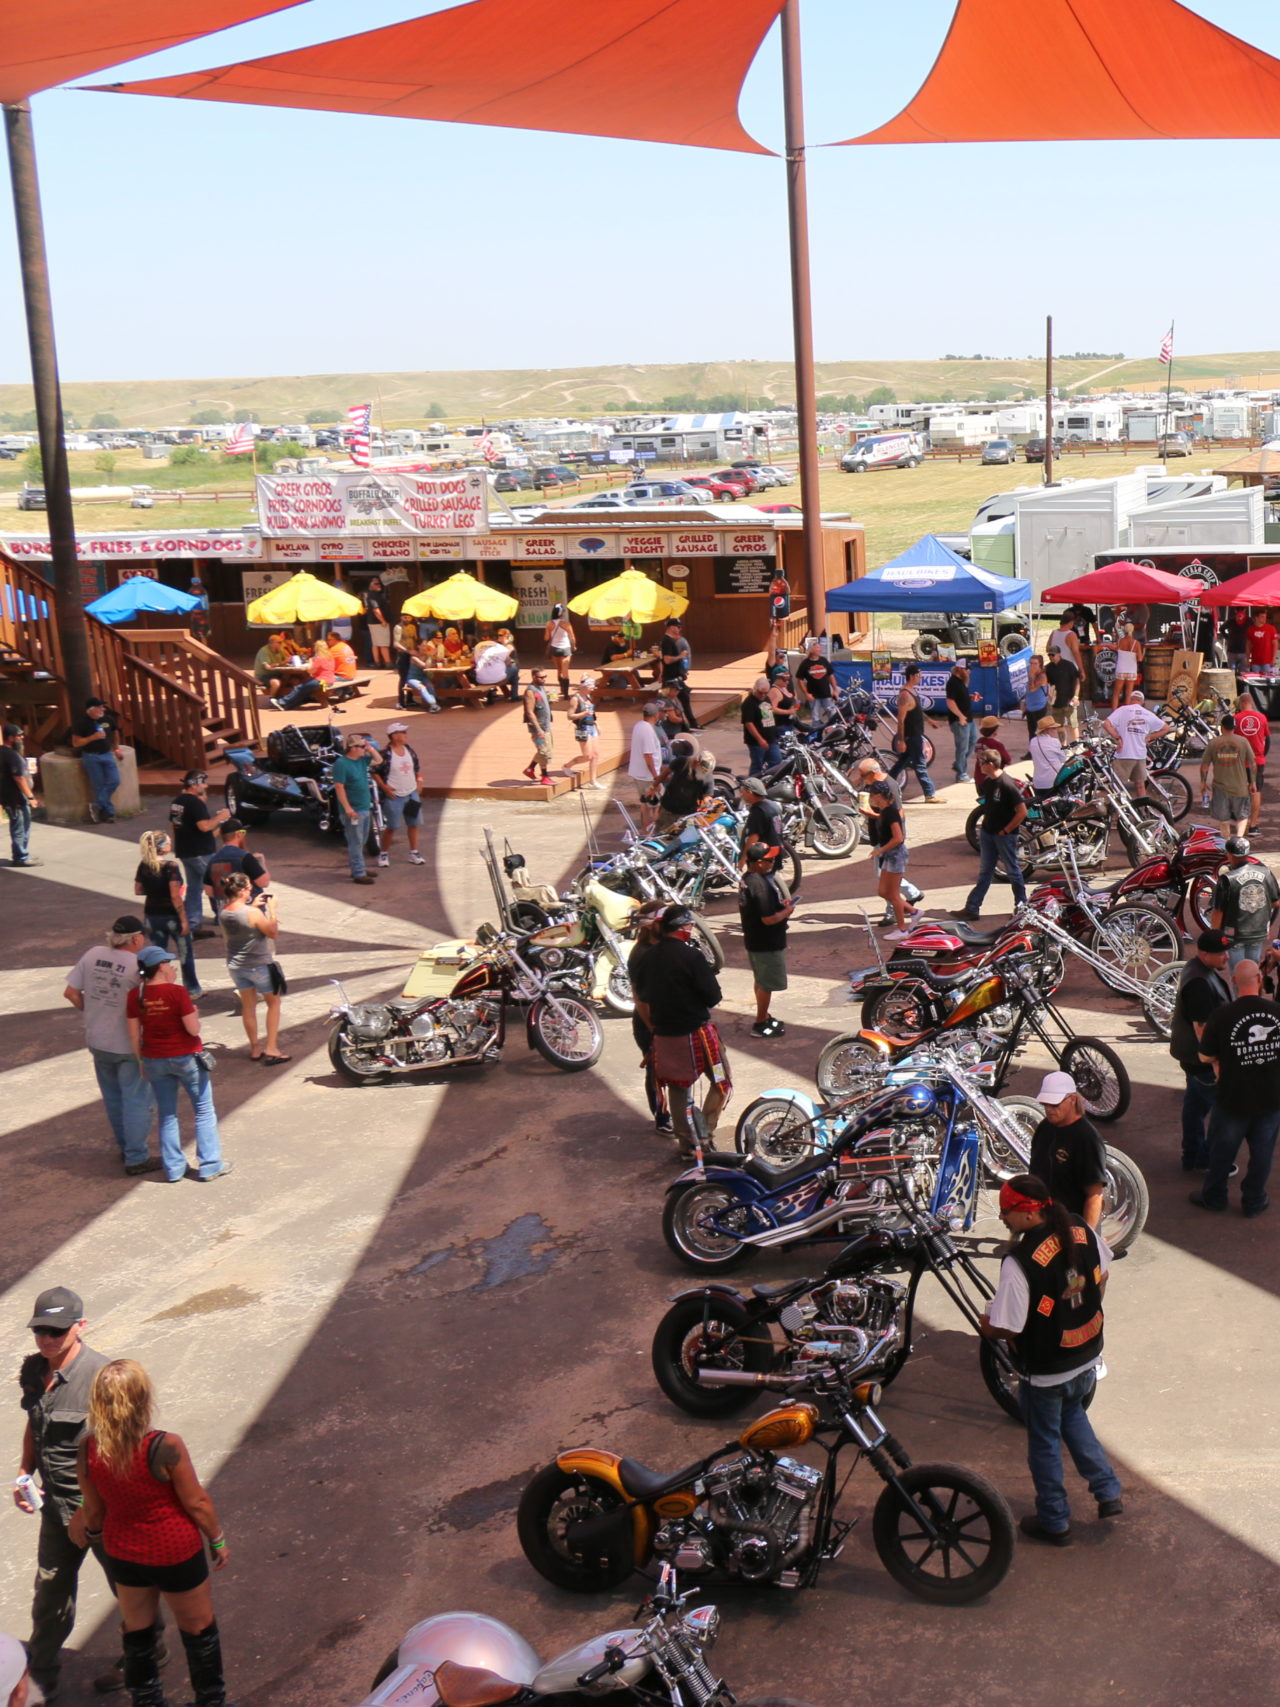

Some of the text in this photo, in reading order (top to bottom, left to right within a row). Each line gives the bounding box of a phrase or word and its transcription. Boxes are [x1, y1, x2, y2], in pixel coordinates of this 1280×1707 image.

[275, 482, 332, 496] GREEK GYROS
[416, 480, 466, 494] HOT DOGS
[348, 489, 380, 499] BUFFALO
[294, 499, 342, 512] CORNDOGS
[404, 496, 482, 511] GRILLED SAUSAGE
[411, 512, 475, 528] TURKEY LEGS
[525, 539, 555, 547] GREEK
[626, 537, 662, 545] VEGGIE
[678, 534, 714, 543] GRILLED
[734, 534, 765, 543] GREEK
[11, 541, 86, 554] BURGS,
[141, 542, 151, 552] &
[155, 539, 242, 552] CORNDOGS
[276, 543, 310, 551] BAKLAVA
[321, 542, 344, 550] GYRO
[372, 540, 410, 548] CHICKEN
[675, 543, 718, 553] SAUSAGE
[732, 543, 767, 552] GYROS
[373, 549, 410, 557] MILANO
[525, 547, 557, 555] SALAD
[623, 545, 665, 554] DELIGHT
